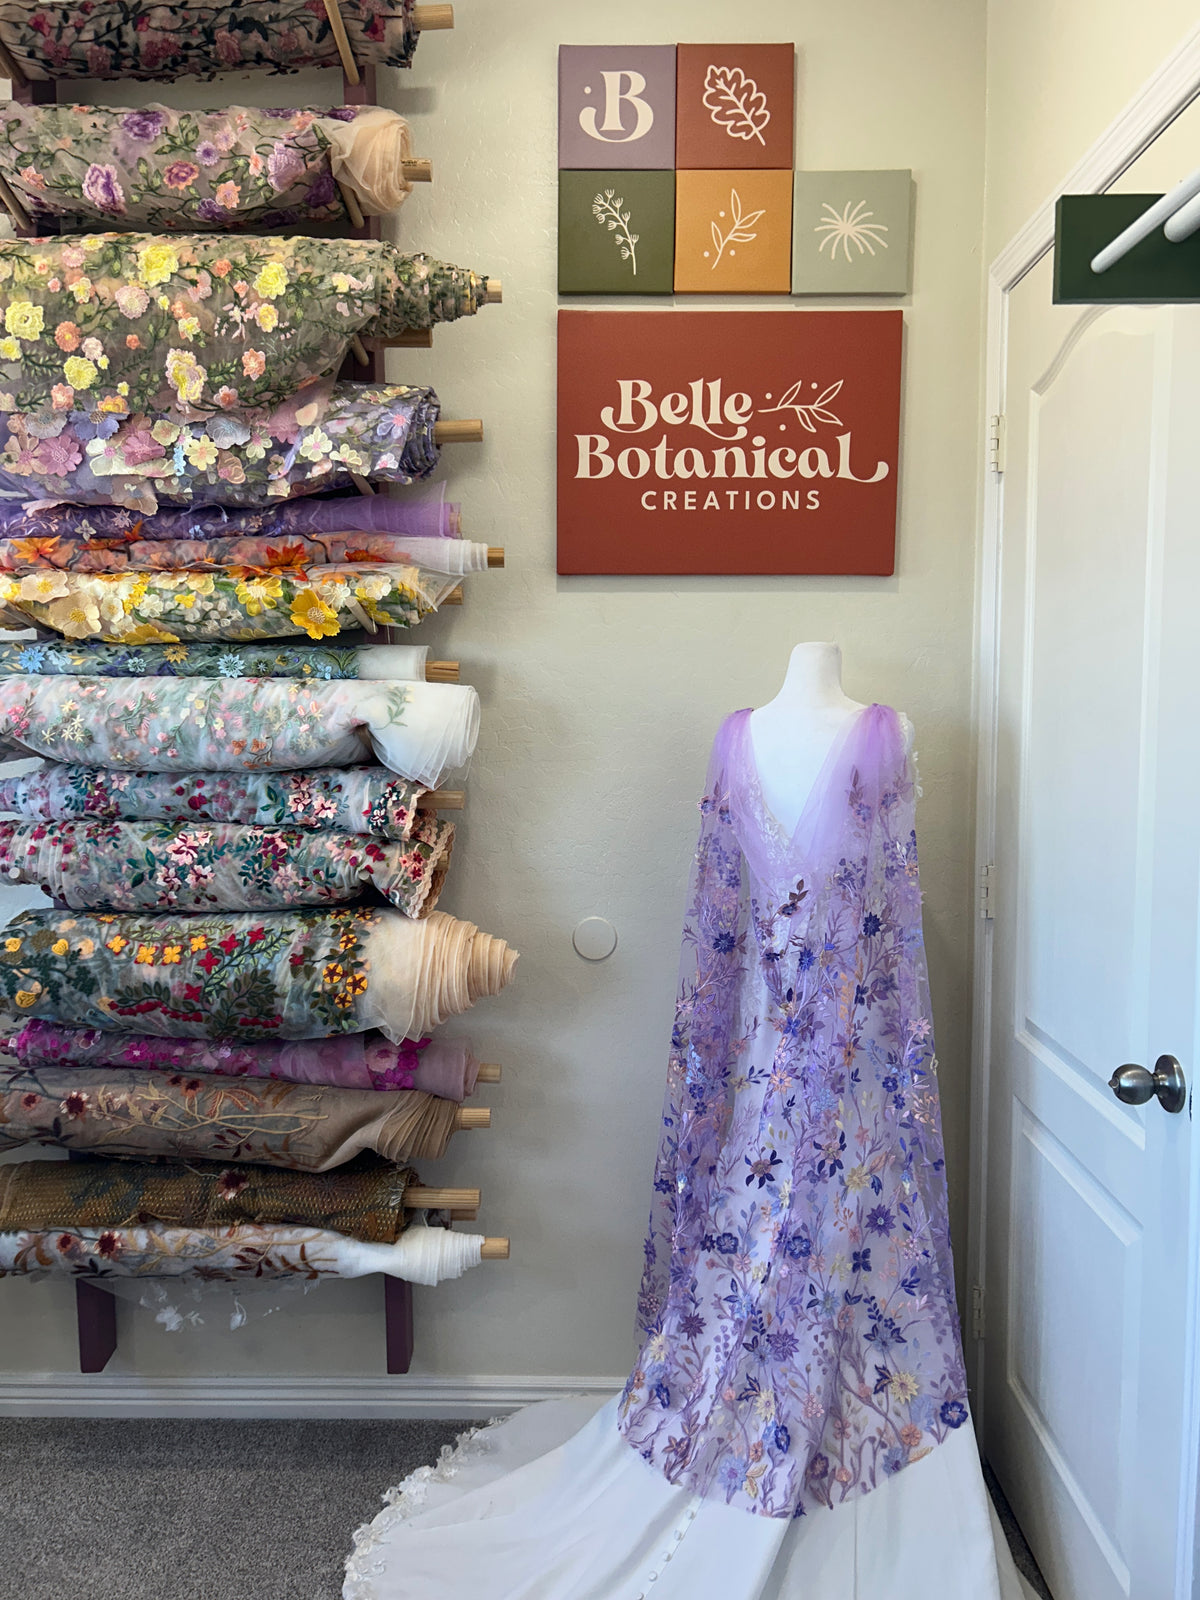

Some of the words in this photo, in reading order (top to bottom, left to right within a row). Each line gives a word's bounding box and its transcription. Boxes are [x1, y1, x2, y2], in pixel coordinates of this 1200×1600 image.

[579, 70, 654, 143] B
[600, 377, 754, 441] Belle
[574, 431, 889, 483] Botanical
[641, 490, 820, 510] CREATIONS
